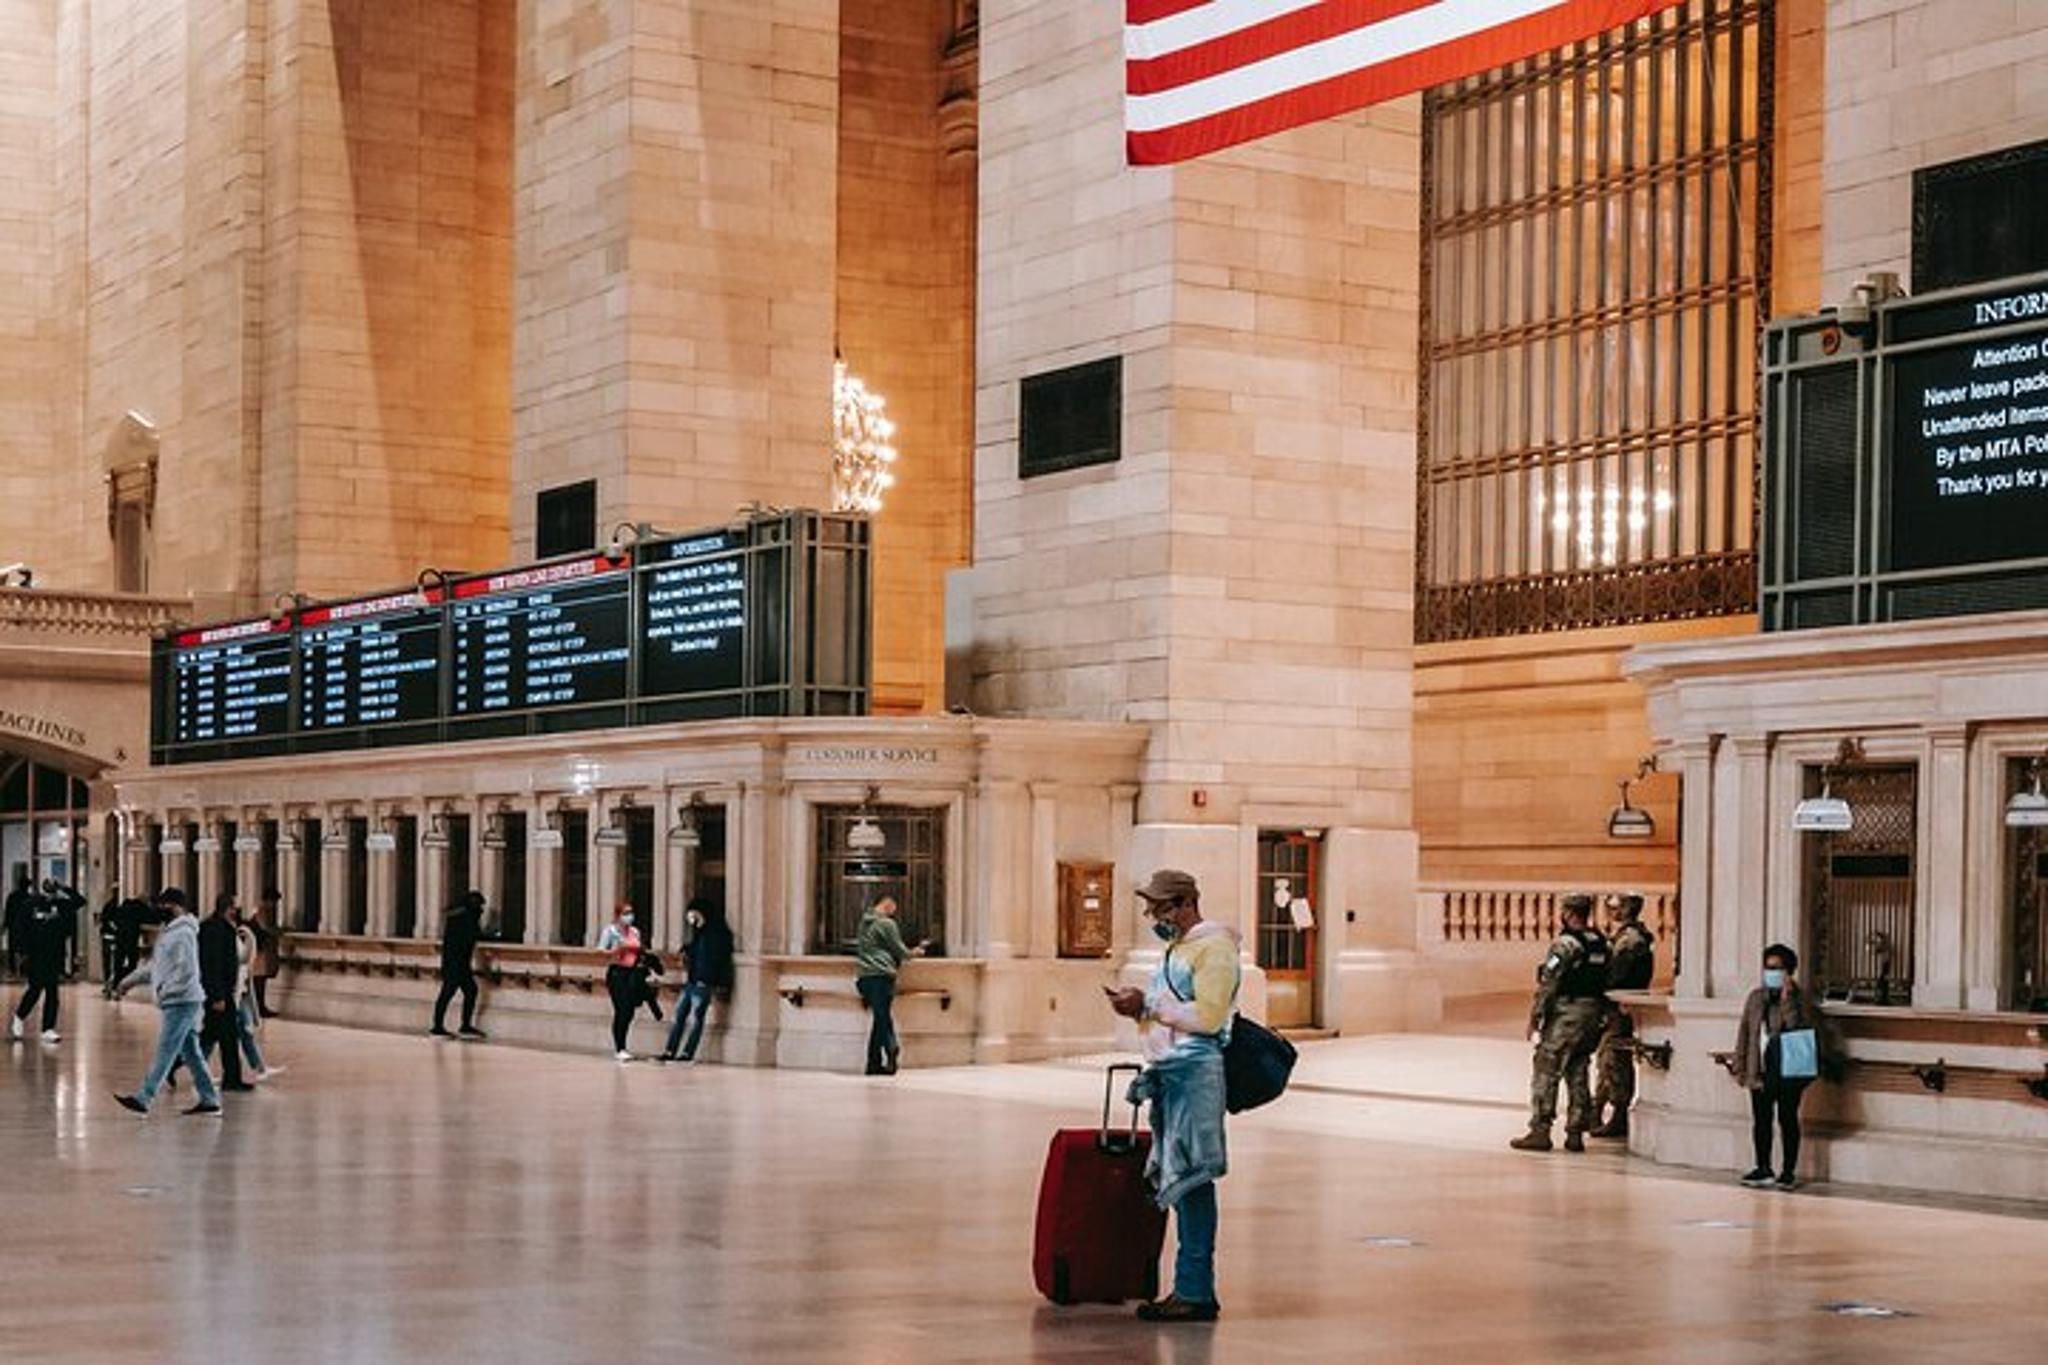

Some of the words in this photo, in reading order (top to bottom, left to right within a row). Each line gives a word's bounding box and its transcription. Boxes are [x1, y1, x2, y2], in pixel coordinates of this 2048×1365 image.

[1972, 344, 2038, 369] Attention
[1924, 386, 1968, 408] Never
[1970, 380, 2010, 400] leave
[1922, 407, 2006, 438] Unattended
[1936, 448, 1957, 469] By
[1959, 444, 1982, 463] the
[1984, 438, 2022, 459] MTA
[1937, 474, 1983, 496] Thank
[1985, 474, 2014, 495] you
[2016, 468, 2037, 487] for
[0, 710, 86, 745] ACHINES
[881, 746, 938, 762] SERVICE
